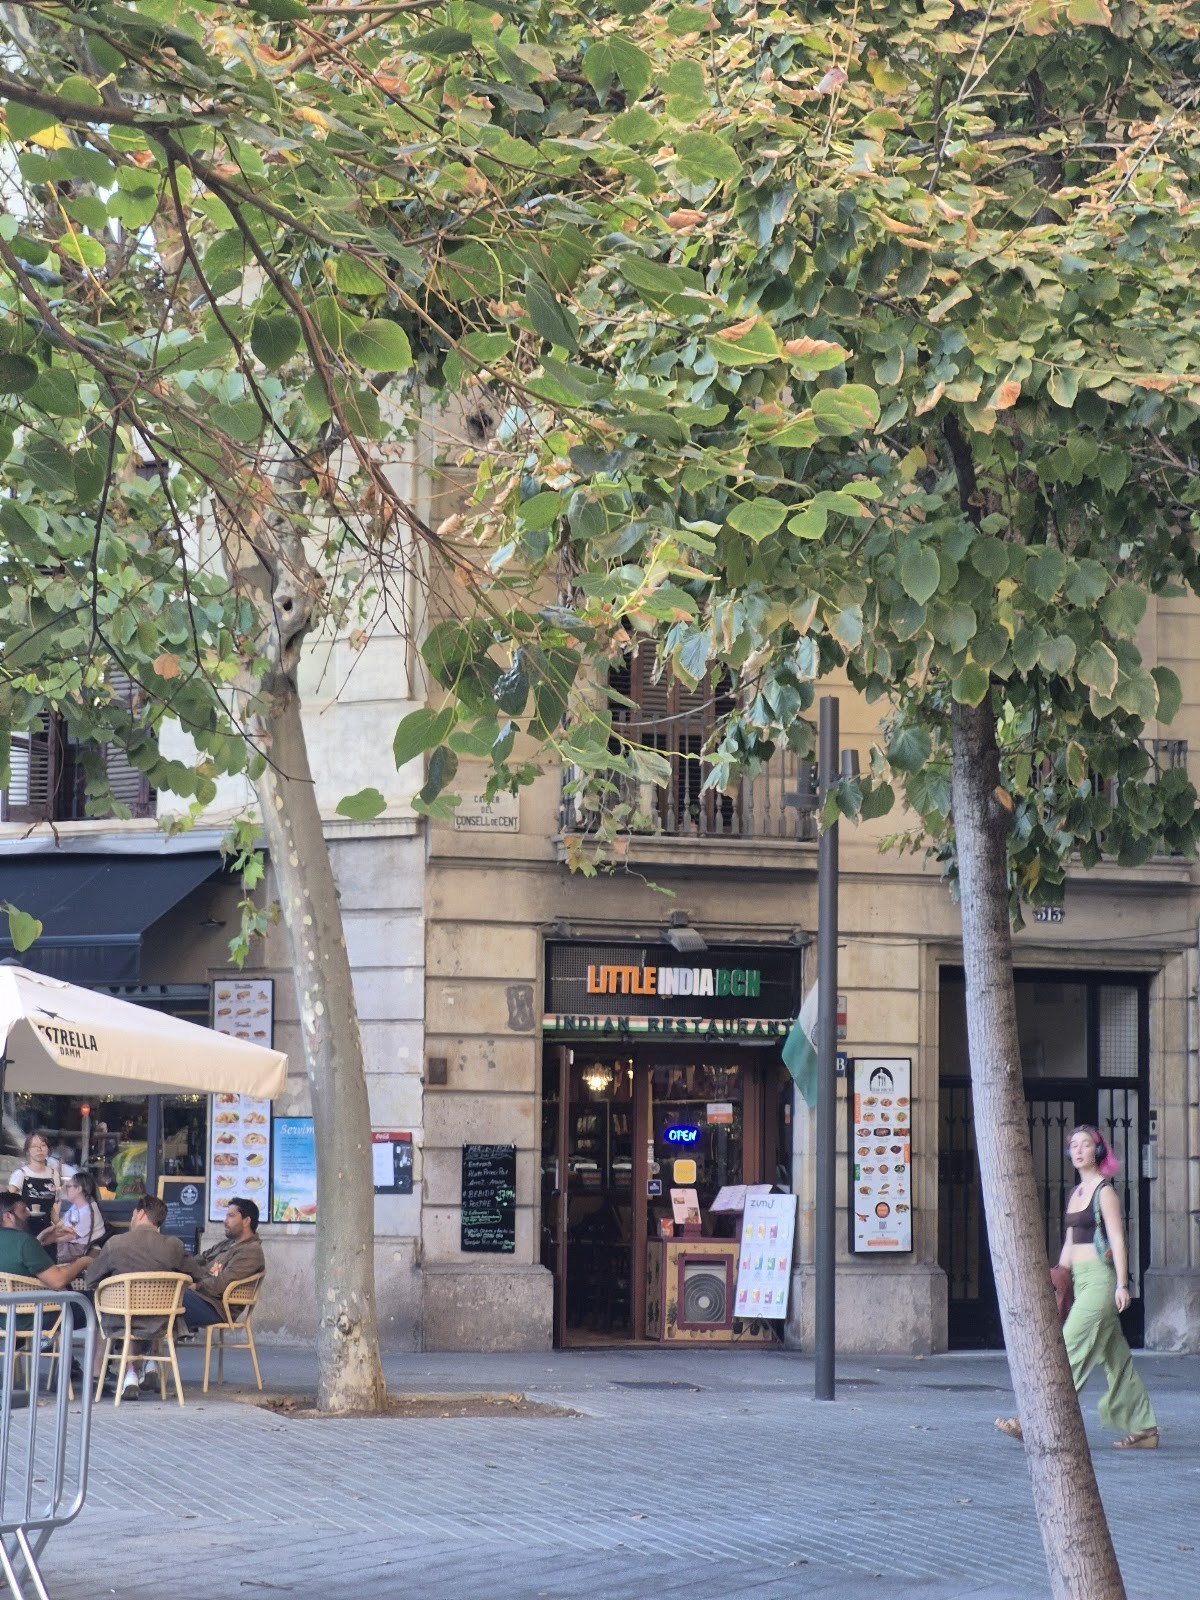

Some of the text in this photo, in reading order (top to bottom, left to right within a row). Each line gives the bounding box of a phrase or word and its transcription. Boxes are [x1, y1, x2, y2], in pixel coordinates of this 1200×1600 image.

[480, 806, 494, 814] DEL
[456, 815, 518, 828] CONSELL DE CENT
[587, 965, 761, 998] LITTLE INDIA BCN
[555, 1015, 797, 1037] INDIAN RESTAURANT
[60, 1046, 81, 1058] DAMM
[668, 1129, 697, 1142] OPEN
